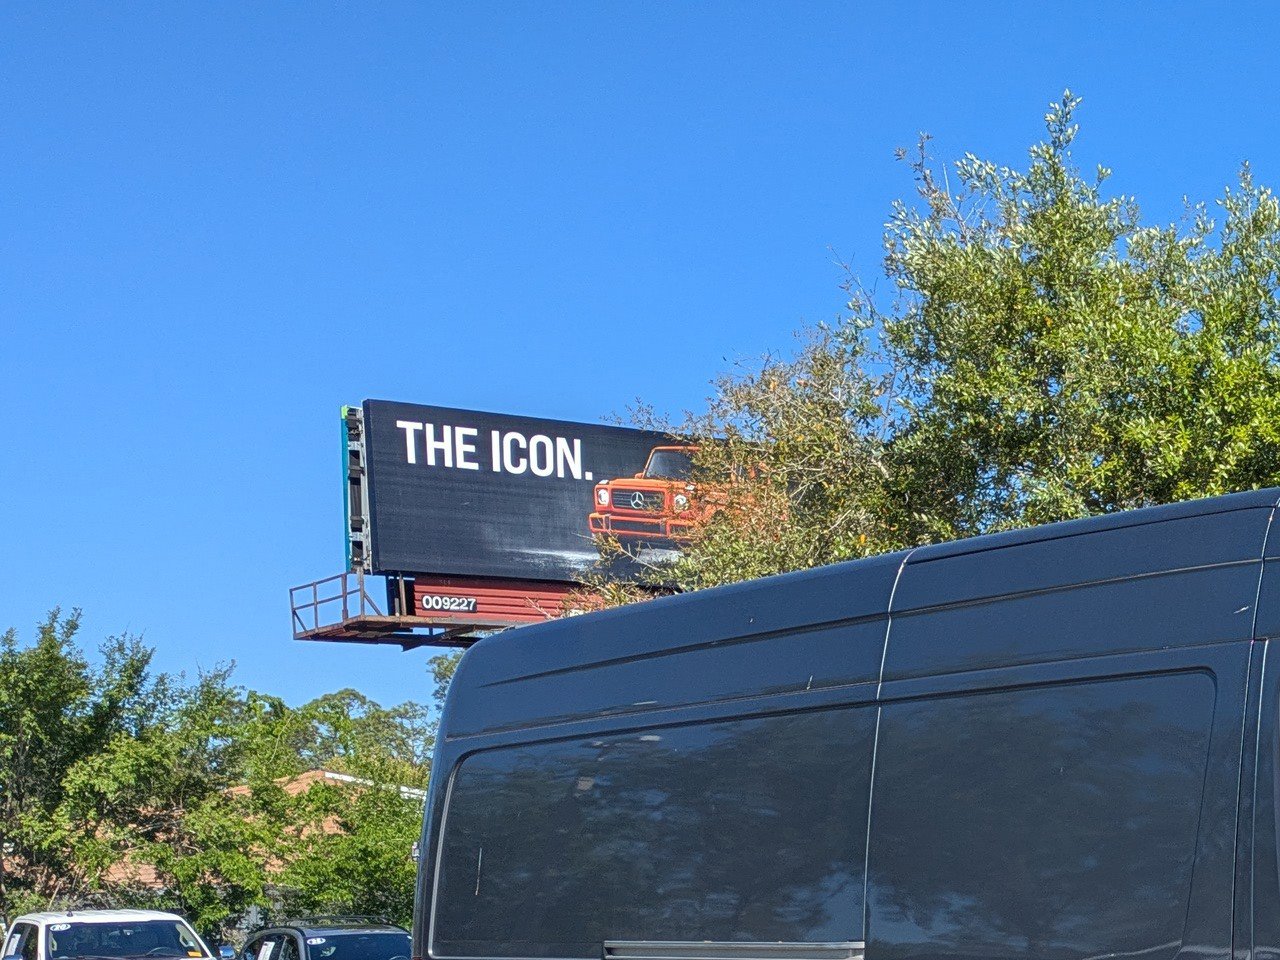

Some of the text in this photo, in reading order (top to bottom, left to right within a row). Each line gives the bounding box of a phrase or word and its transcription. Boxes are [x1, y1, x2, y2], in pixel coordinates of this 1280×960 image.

[396, 420, 593, 481] THE ICON.
[422, 595, 476, 610] 009227
